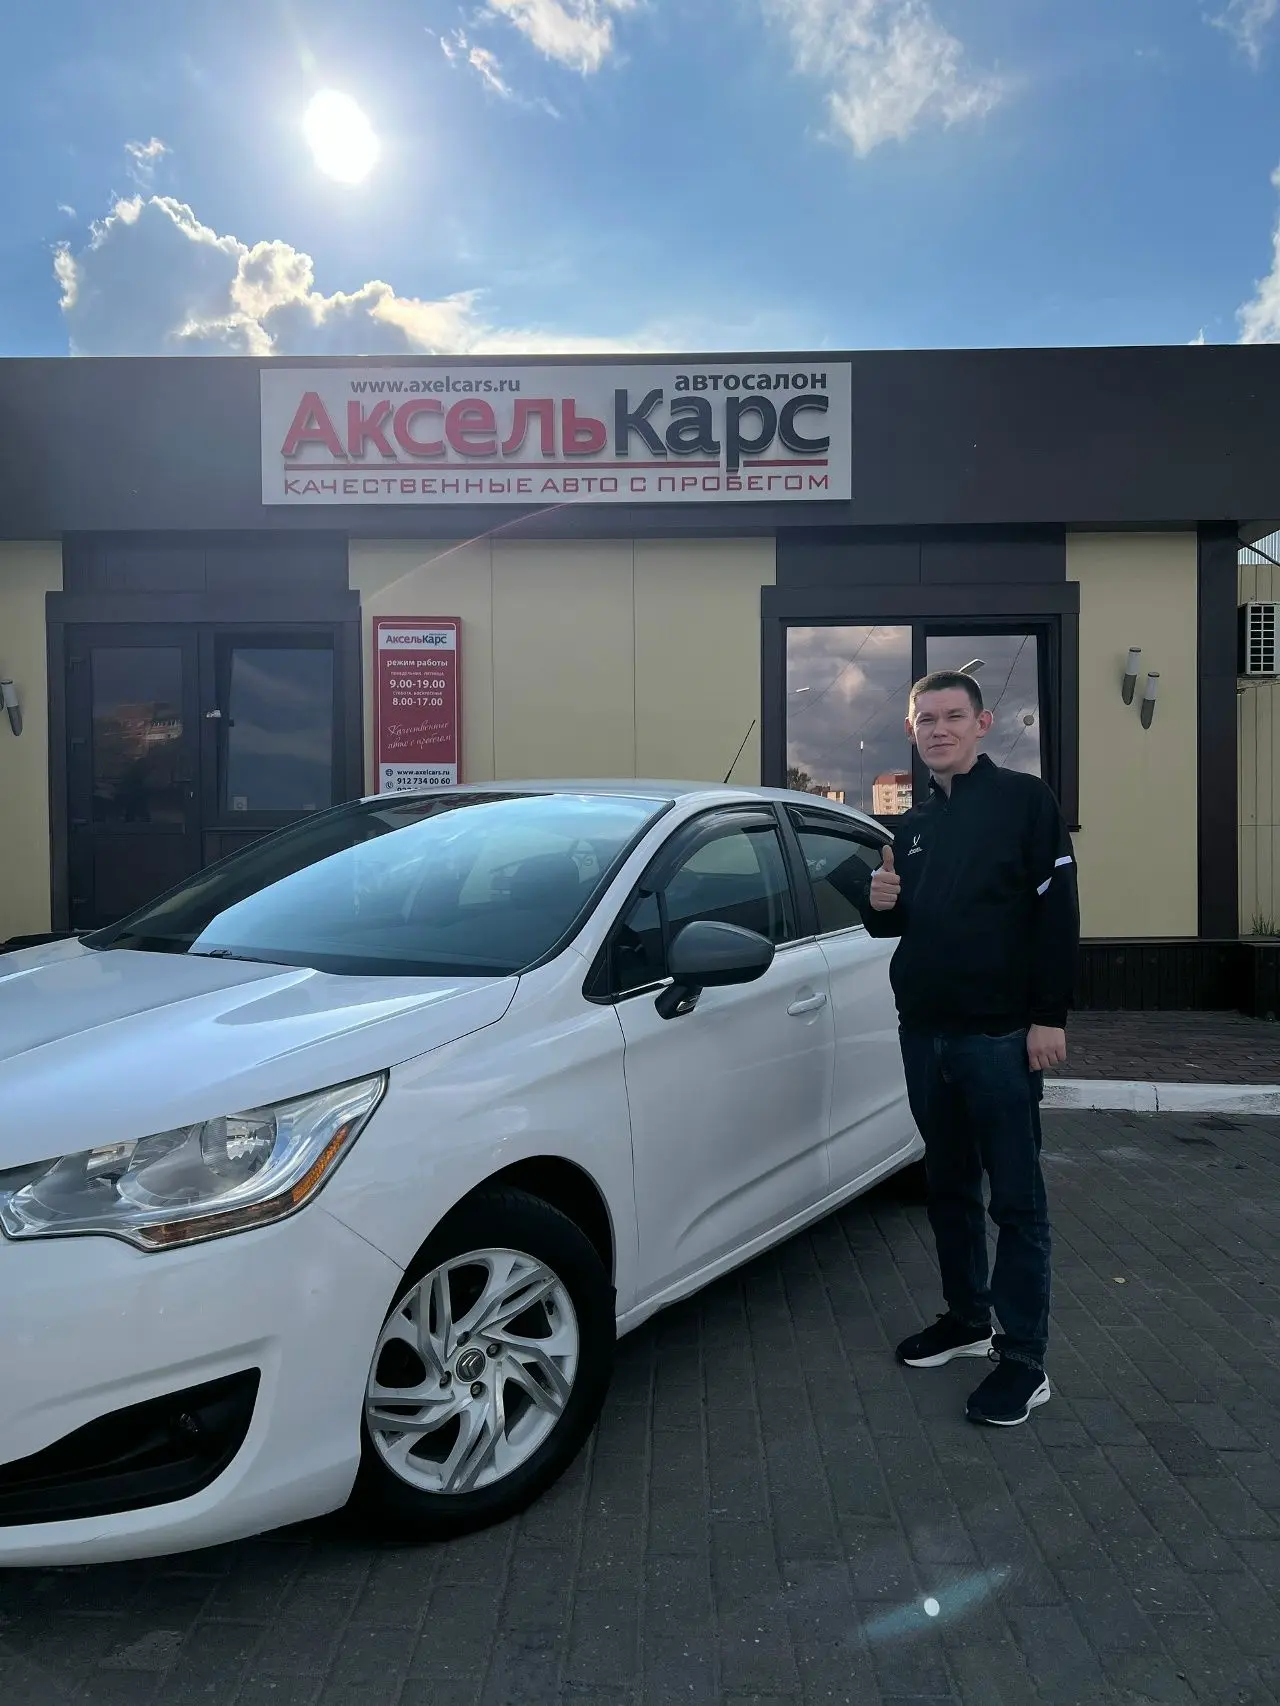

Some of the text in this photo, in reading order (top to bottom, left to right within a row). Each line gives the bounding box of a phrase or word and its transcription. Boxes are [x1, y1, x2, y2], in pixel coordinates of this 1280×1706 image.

[350, 376, 521, 393] www.axelcars.ru
[674, 373, 827, 391] автосалон
[284, 474, 829, 495] КАЧЕСТВЕННЫЕ АВТО С ПРОБЕГОМ
[386, 635, 447, 645] АксельКарс
[386, 659, 448, 668] режим работы
[389, 680, 446, 689] 9.00-19.00
[392, 698, 443, 706] 8.00-17.00
